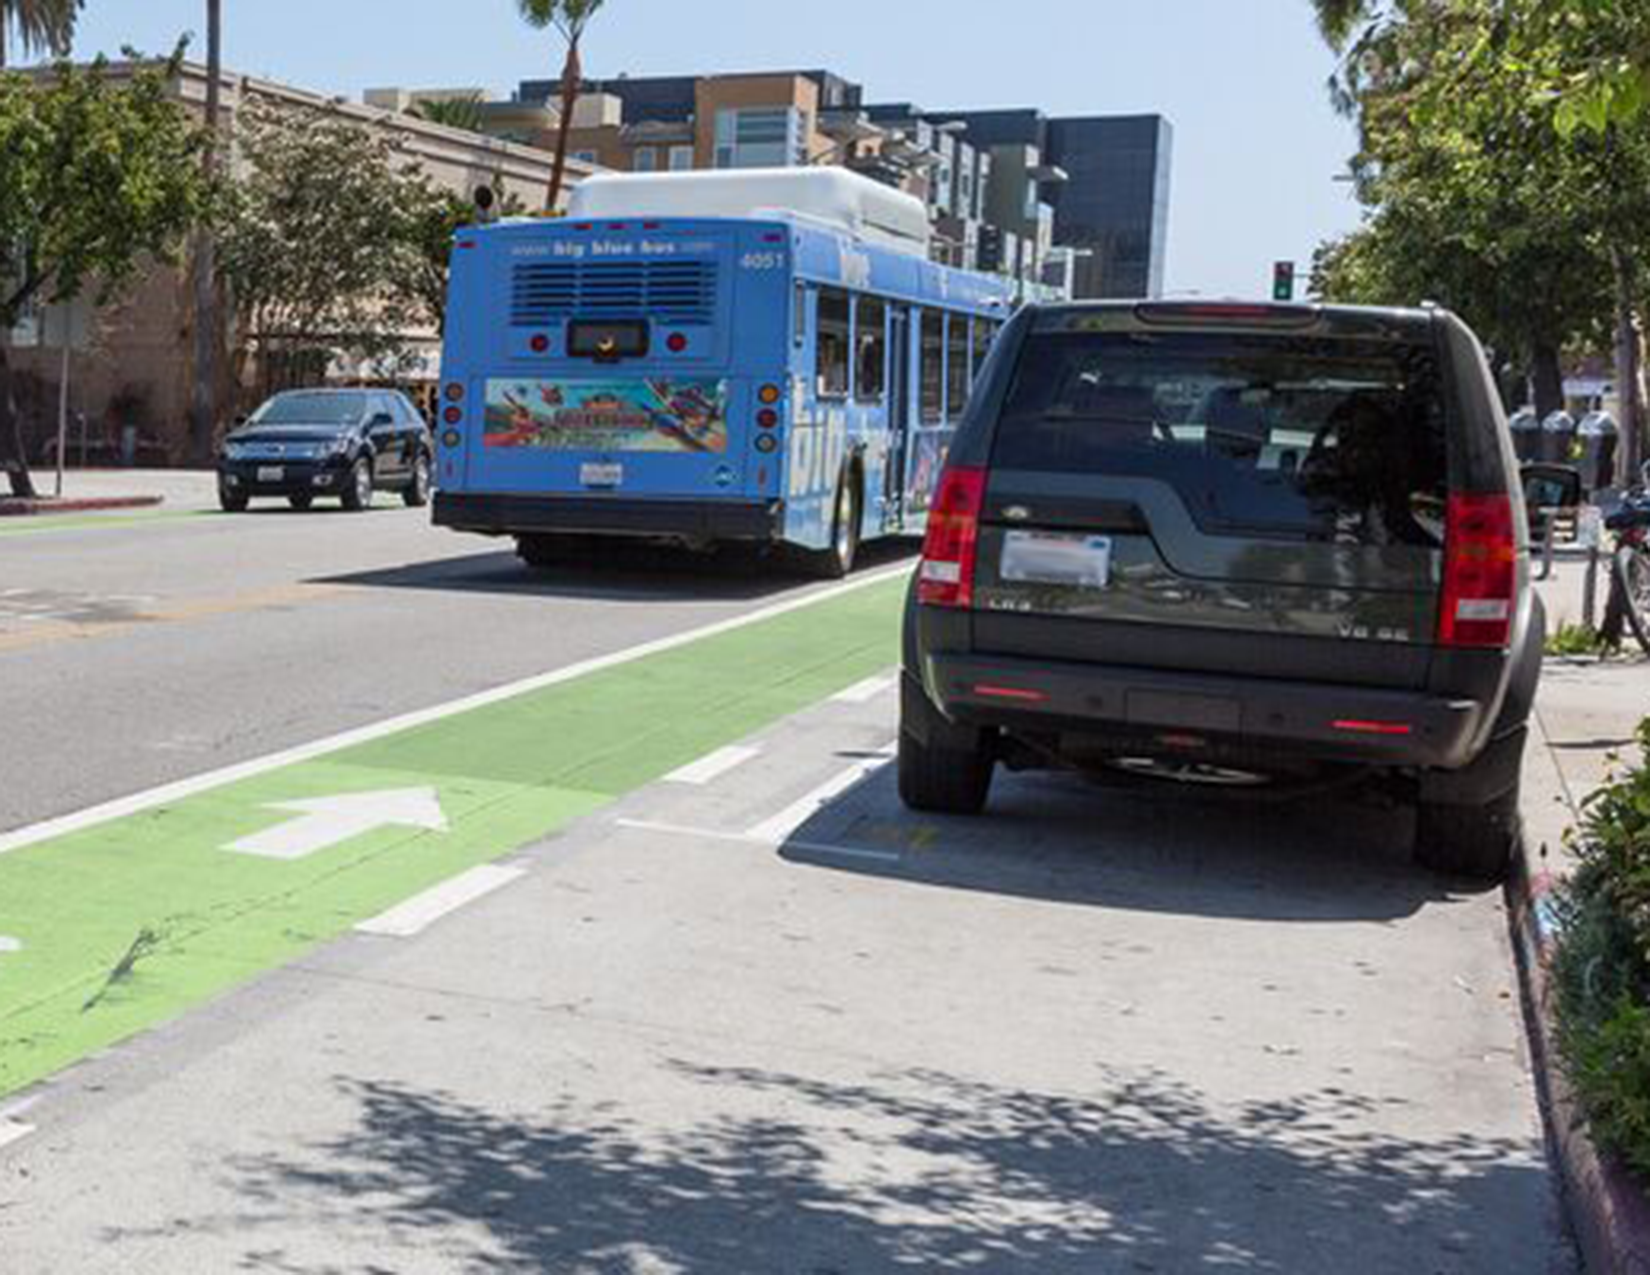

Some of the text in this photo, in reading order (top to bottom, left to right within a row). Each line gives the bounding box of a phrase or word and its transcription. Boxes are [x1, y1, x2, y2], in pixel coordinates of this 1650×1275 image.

[553, 240, 585, 258] big
[592, 239, 633, 256] blue
[641, 239, 676, 255] bus
[740, 252, 785, 269] 4051
